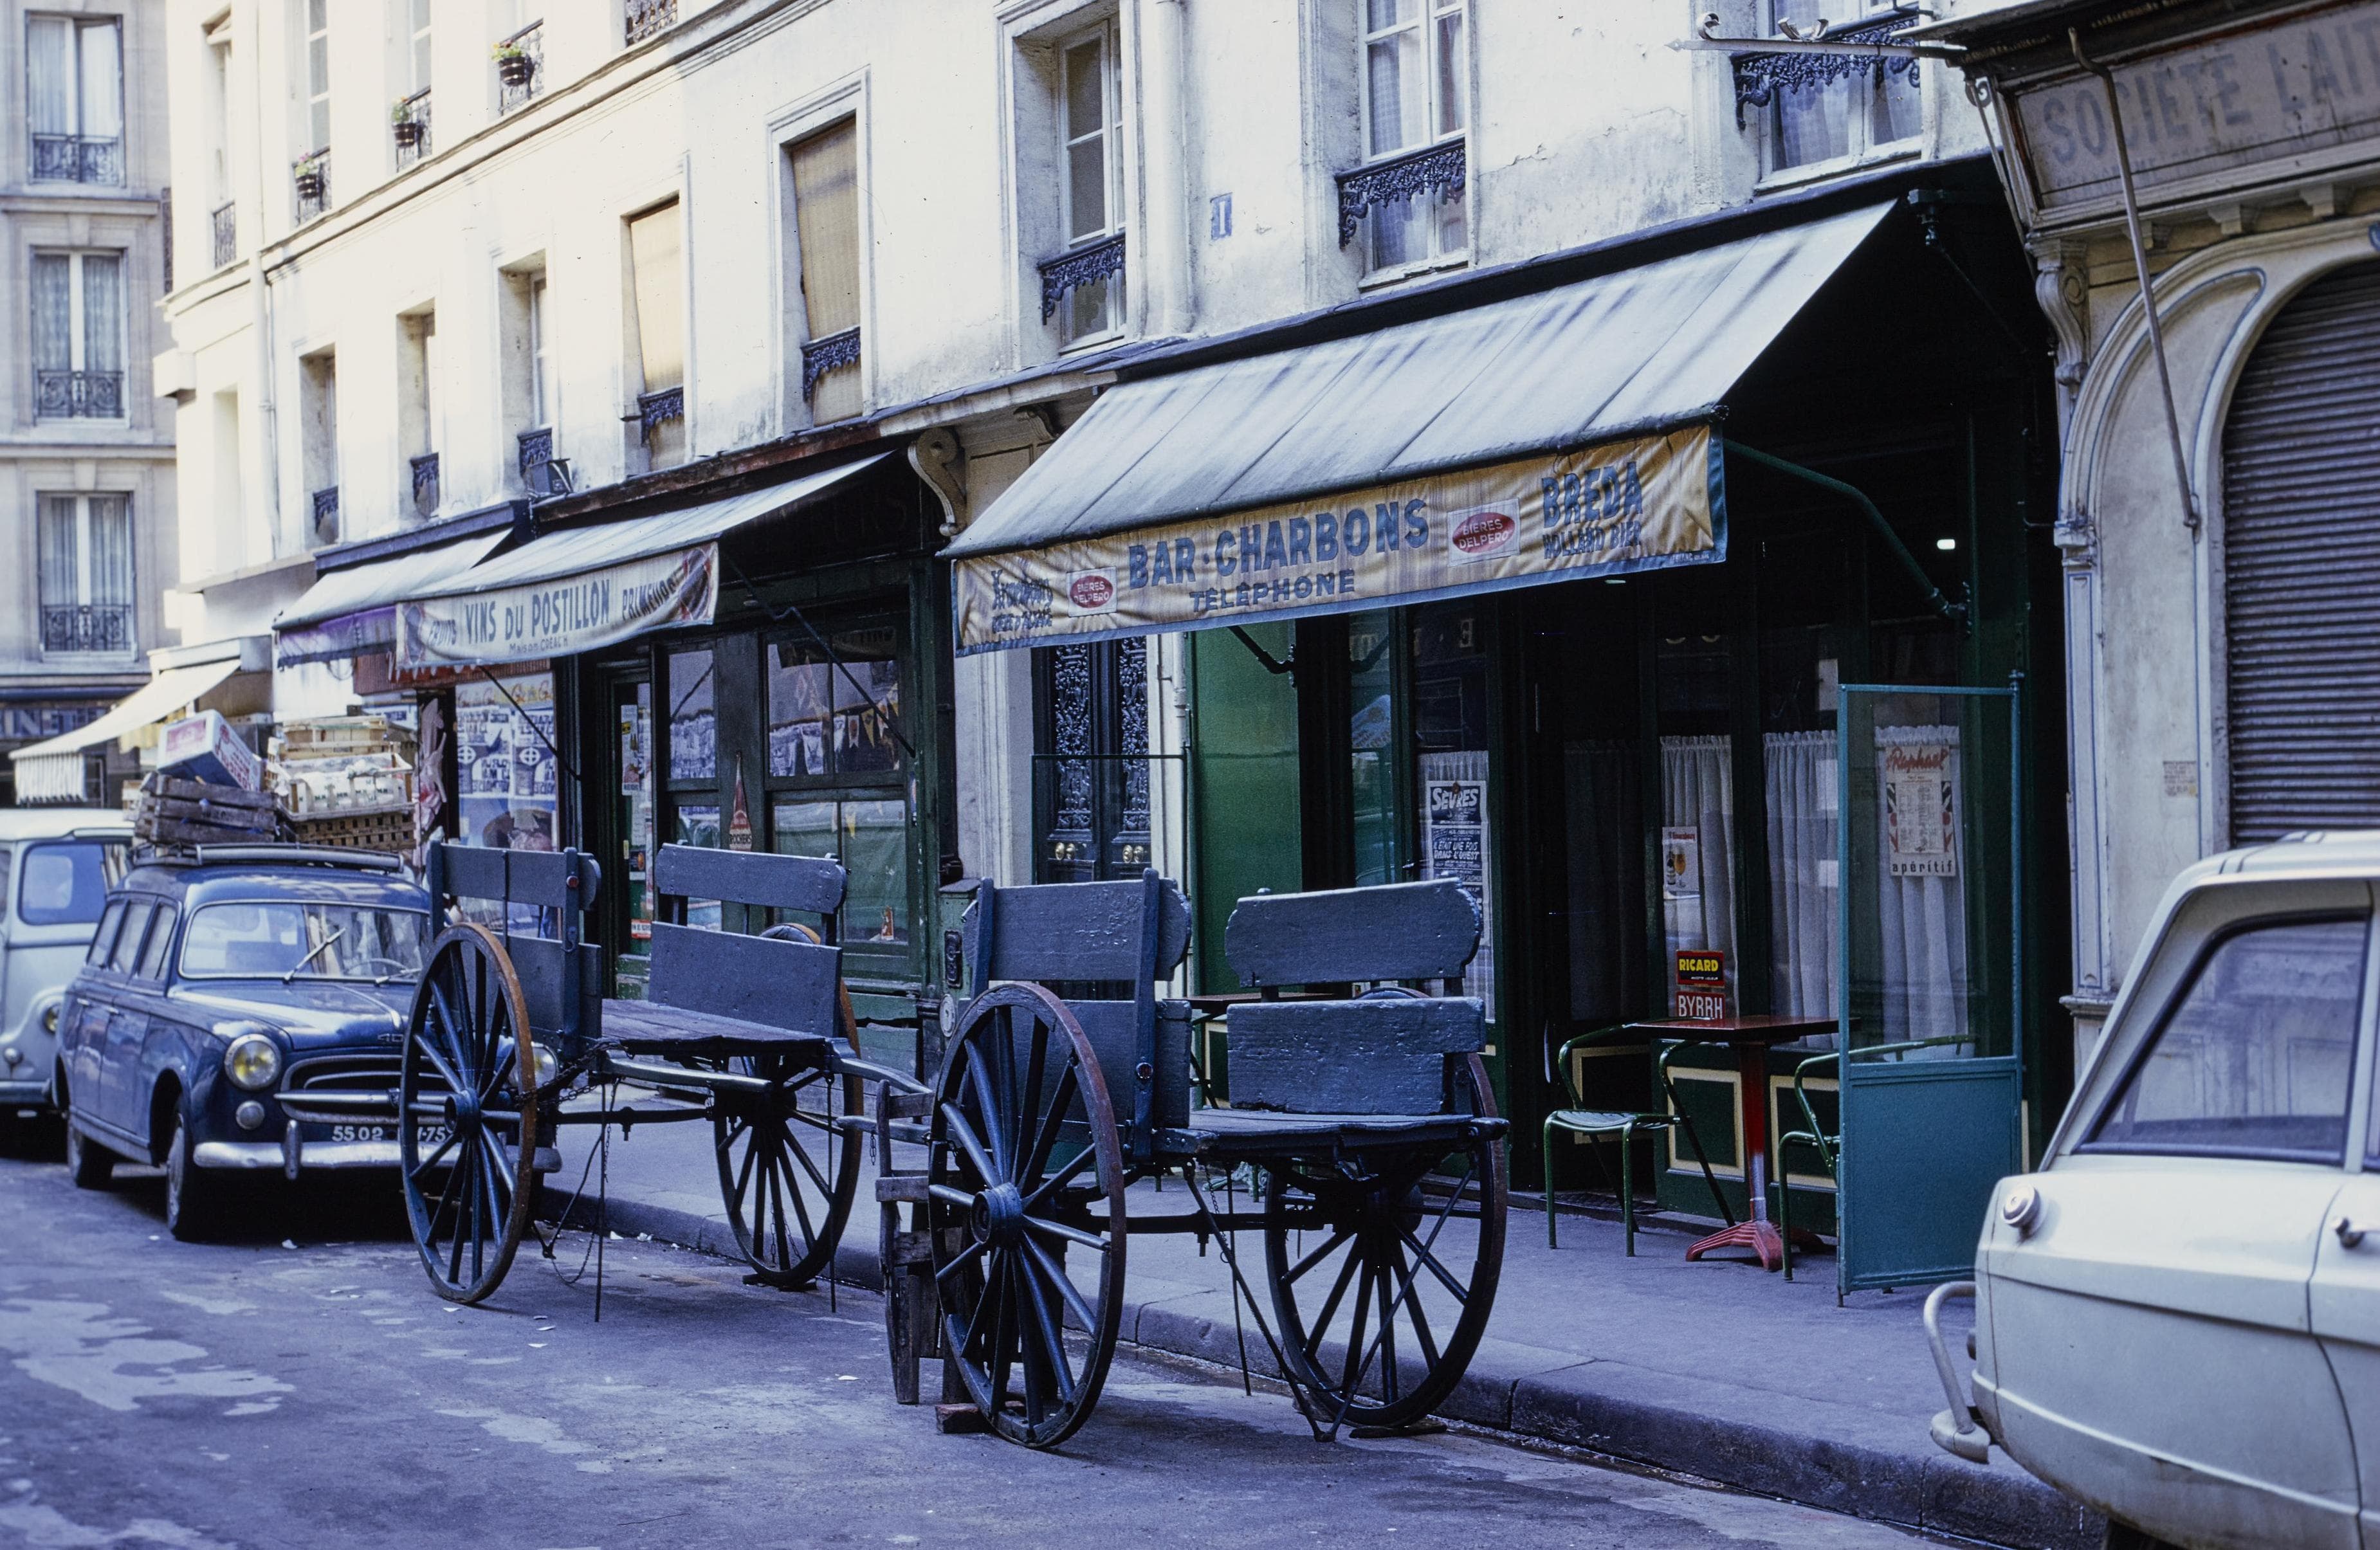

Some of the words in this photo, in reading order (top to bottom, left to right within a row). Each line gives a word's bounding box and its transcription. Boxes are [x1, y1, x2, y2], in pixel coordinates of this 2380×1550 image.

[1542, 460, 1643, 529] BREDA
[1462, 518, 1504, 536] BIERES
[1128, 536, 1196, 590] BAR
[1214, 498, 1429, 578] CHARBONS
[1459, 531, 1509, 549] DELPERO
[1542, 526, 1606, 559] HOLLAND
[1609, 520, 1642, 548] BIER
[1074, 591, 1110, 603] DELPERO
[1077, 581, 1106, 592] BIERES
[1189, 568, 1355, 613] TÉLÉPHONE
[465, 600, 496, 644] VINS
[506, 606, 523, 641] DU
[532, 579, 610, 637] POSTILLON
[1431, 787, 1479, 811] SÈVRES
[1892, 861, 1952, 874] apéritif
[1678, 958, 1719, 972] RICARD
[1678, 995, 1723, 1020] BYRRH
[332, 1126, 383, 1142] 5502
